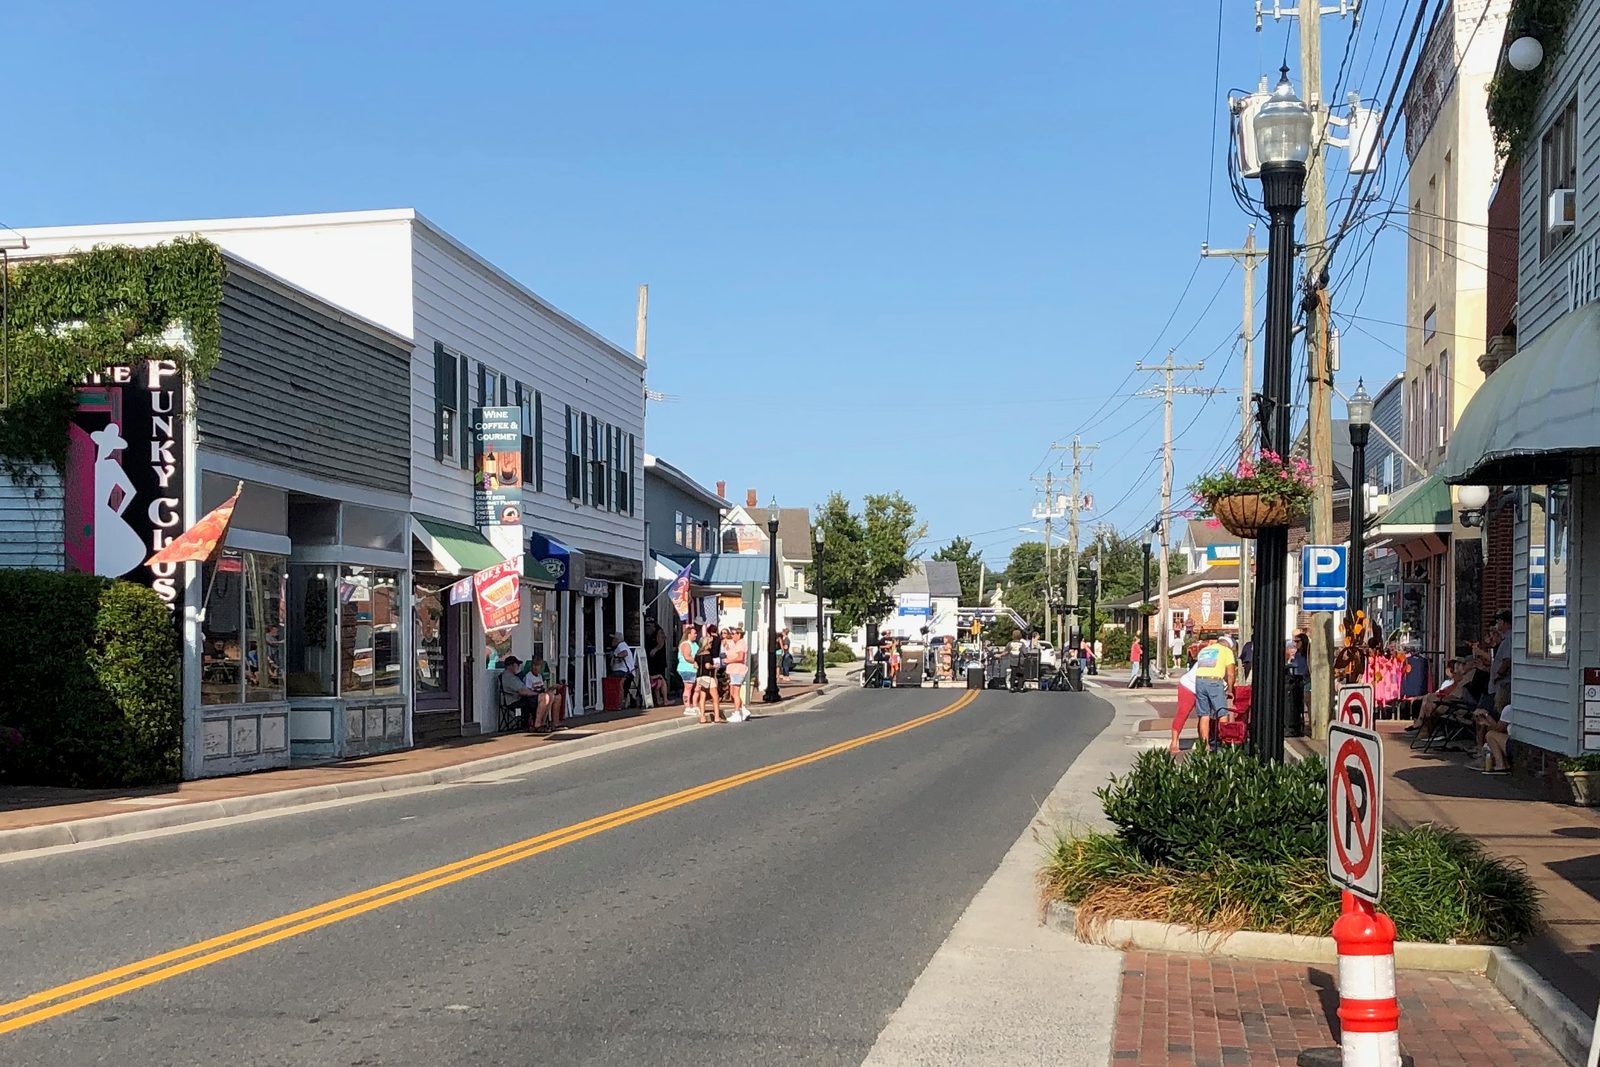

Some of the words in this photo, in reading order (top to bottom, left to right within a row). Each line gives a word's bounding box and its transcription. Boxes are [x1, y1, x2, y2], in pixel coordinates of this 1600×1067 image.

[82, 366, 131, 383] HE
[148, 359, 177, 488] FUNKY
[475, 422, 510, 430] COFFEE
[510, 421, 519, 430] &
[483, 411, 508, 419] WINE
[476, 433, 517, 441] GOURMET
[148, 498, 180, 624] CLOS
[1309, 548, 1341, 586] P
[1345, 764, 1367, 850] P
